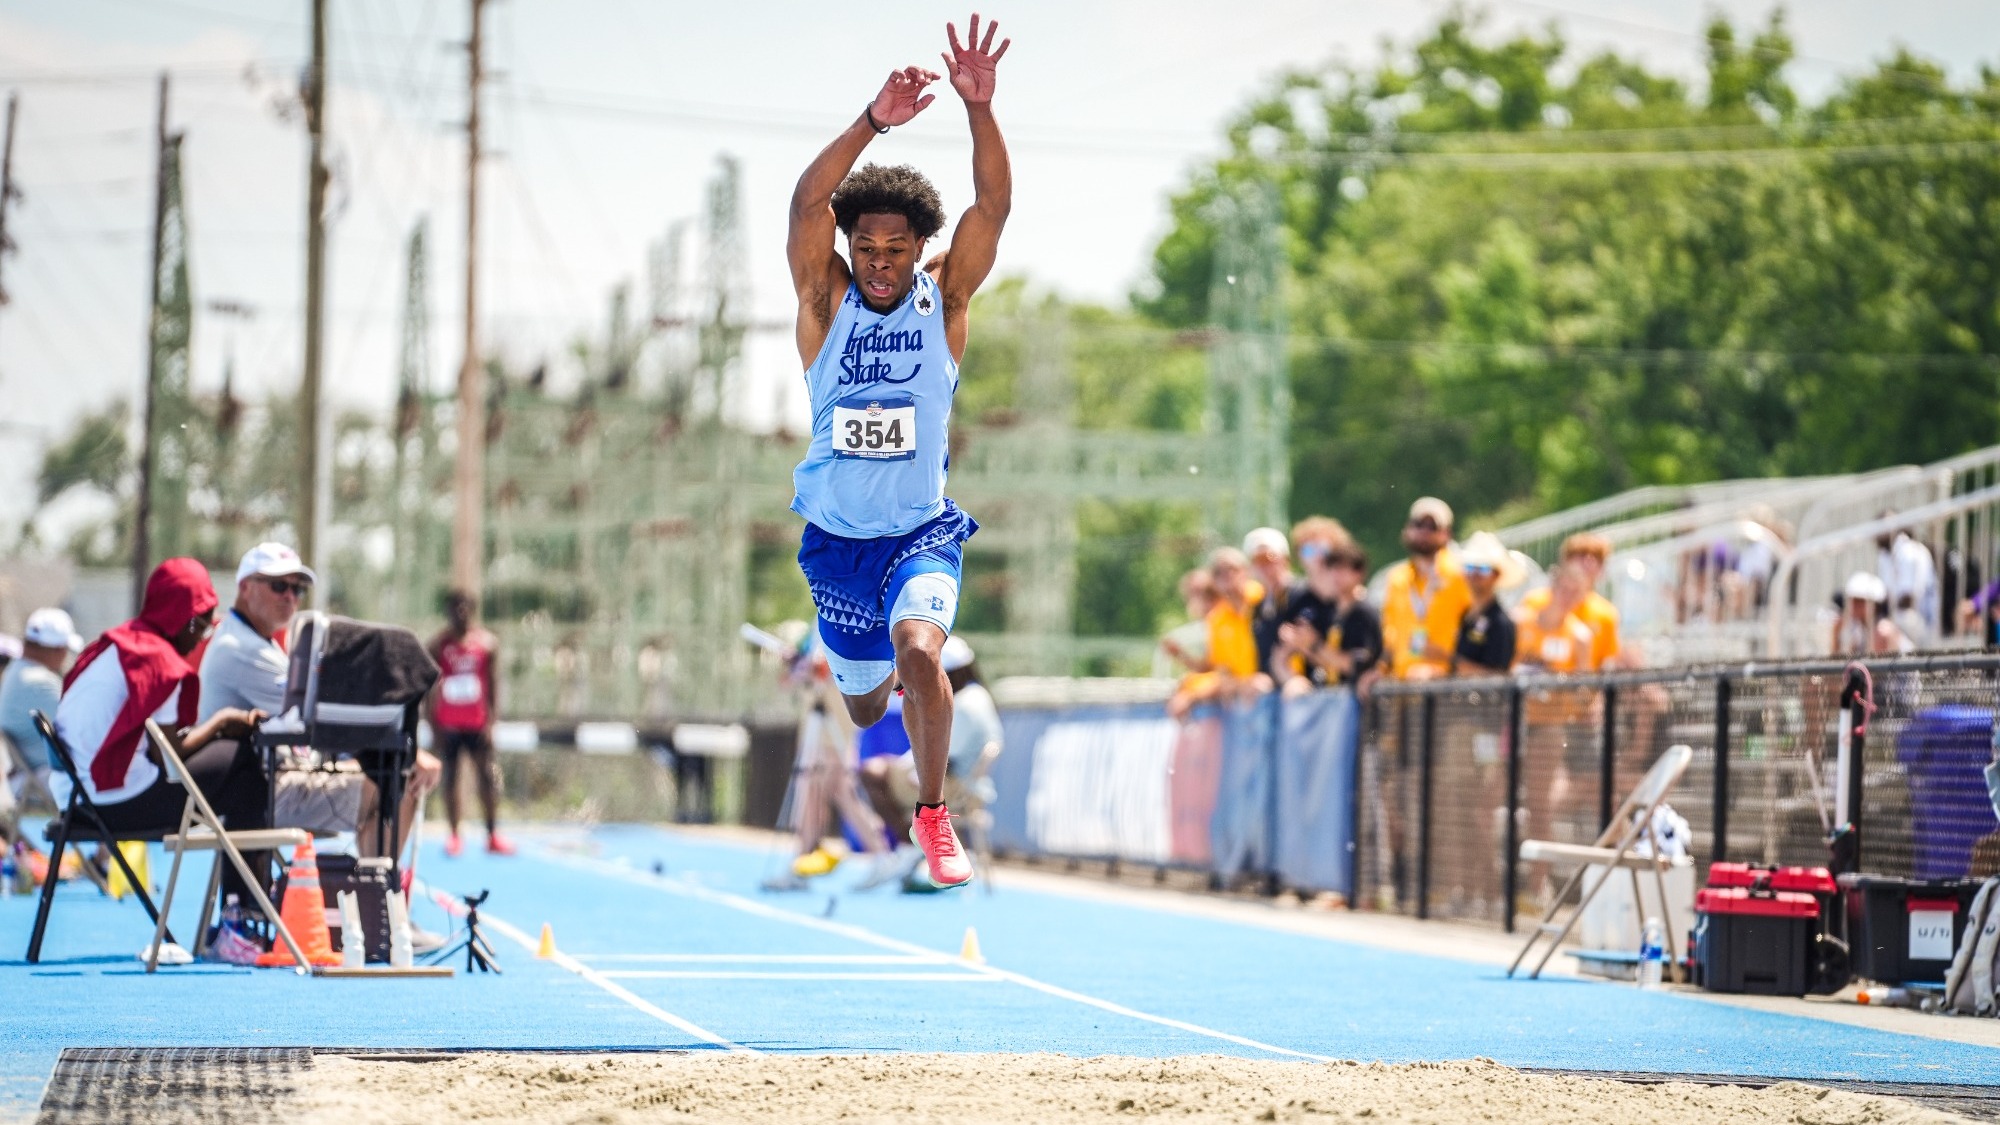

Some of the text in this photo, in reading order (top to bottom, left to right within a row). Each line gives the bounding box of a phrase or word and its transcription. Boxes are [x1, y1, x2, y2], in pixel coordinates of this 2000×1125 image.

[842, 322, 923, 354] Indiana
[838, 349, 921, 385] State
[845, 419, 904, 449] 354
